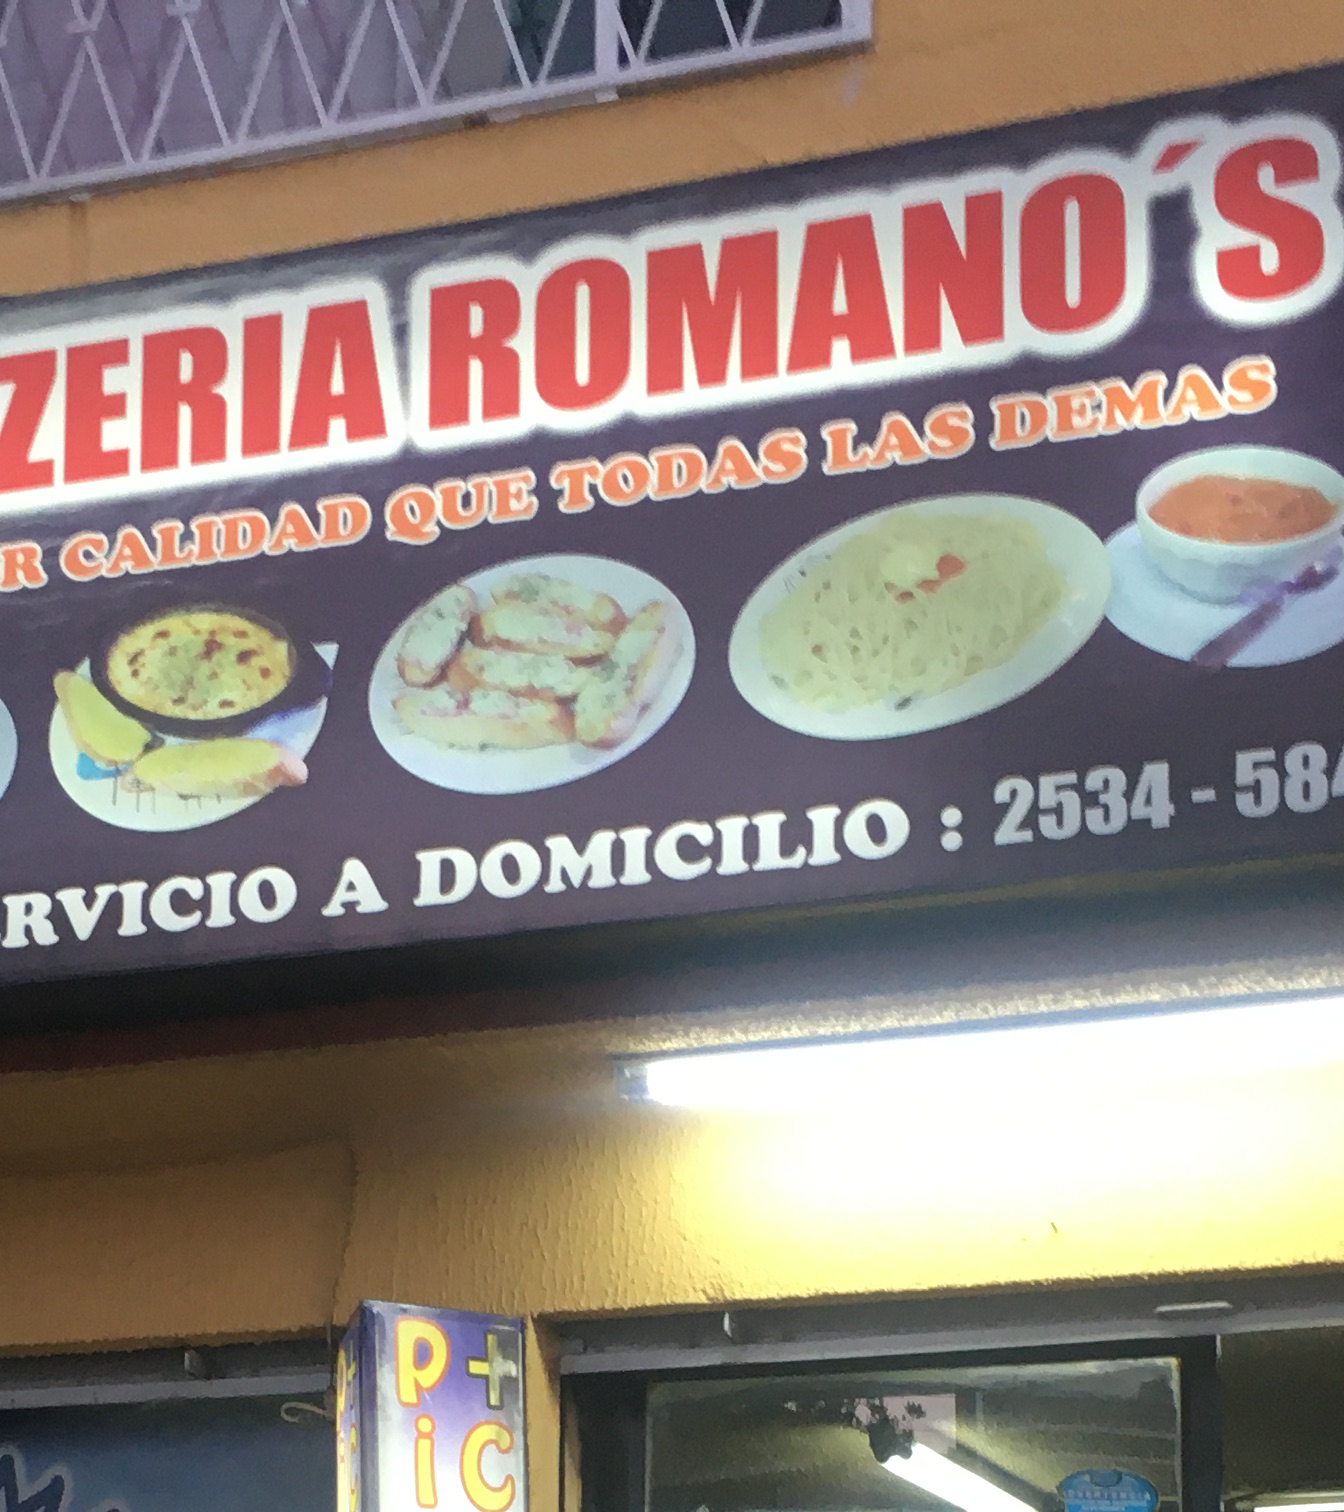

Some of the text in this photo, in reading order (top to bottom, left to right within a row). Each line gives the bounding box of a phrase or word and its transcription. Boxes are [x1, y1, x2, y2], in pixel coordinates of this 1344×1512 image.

[60, 495, 371, 580] CALIDAD
[387, 468, 536, 544] QUE
[551, 425, 807, 514] TODAS
[825, 403, 976, 474] LAS
[991, 356, 1278, 450] DEMAS
[322, 858, 388, 917] A
[413, 799, 909, 908] DOMICILIO
